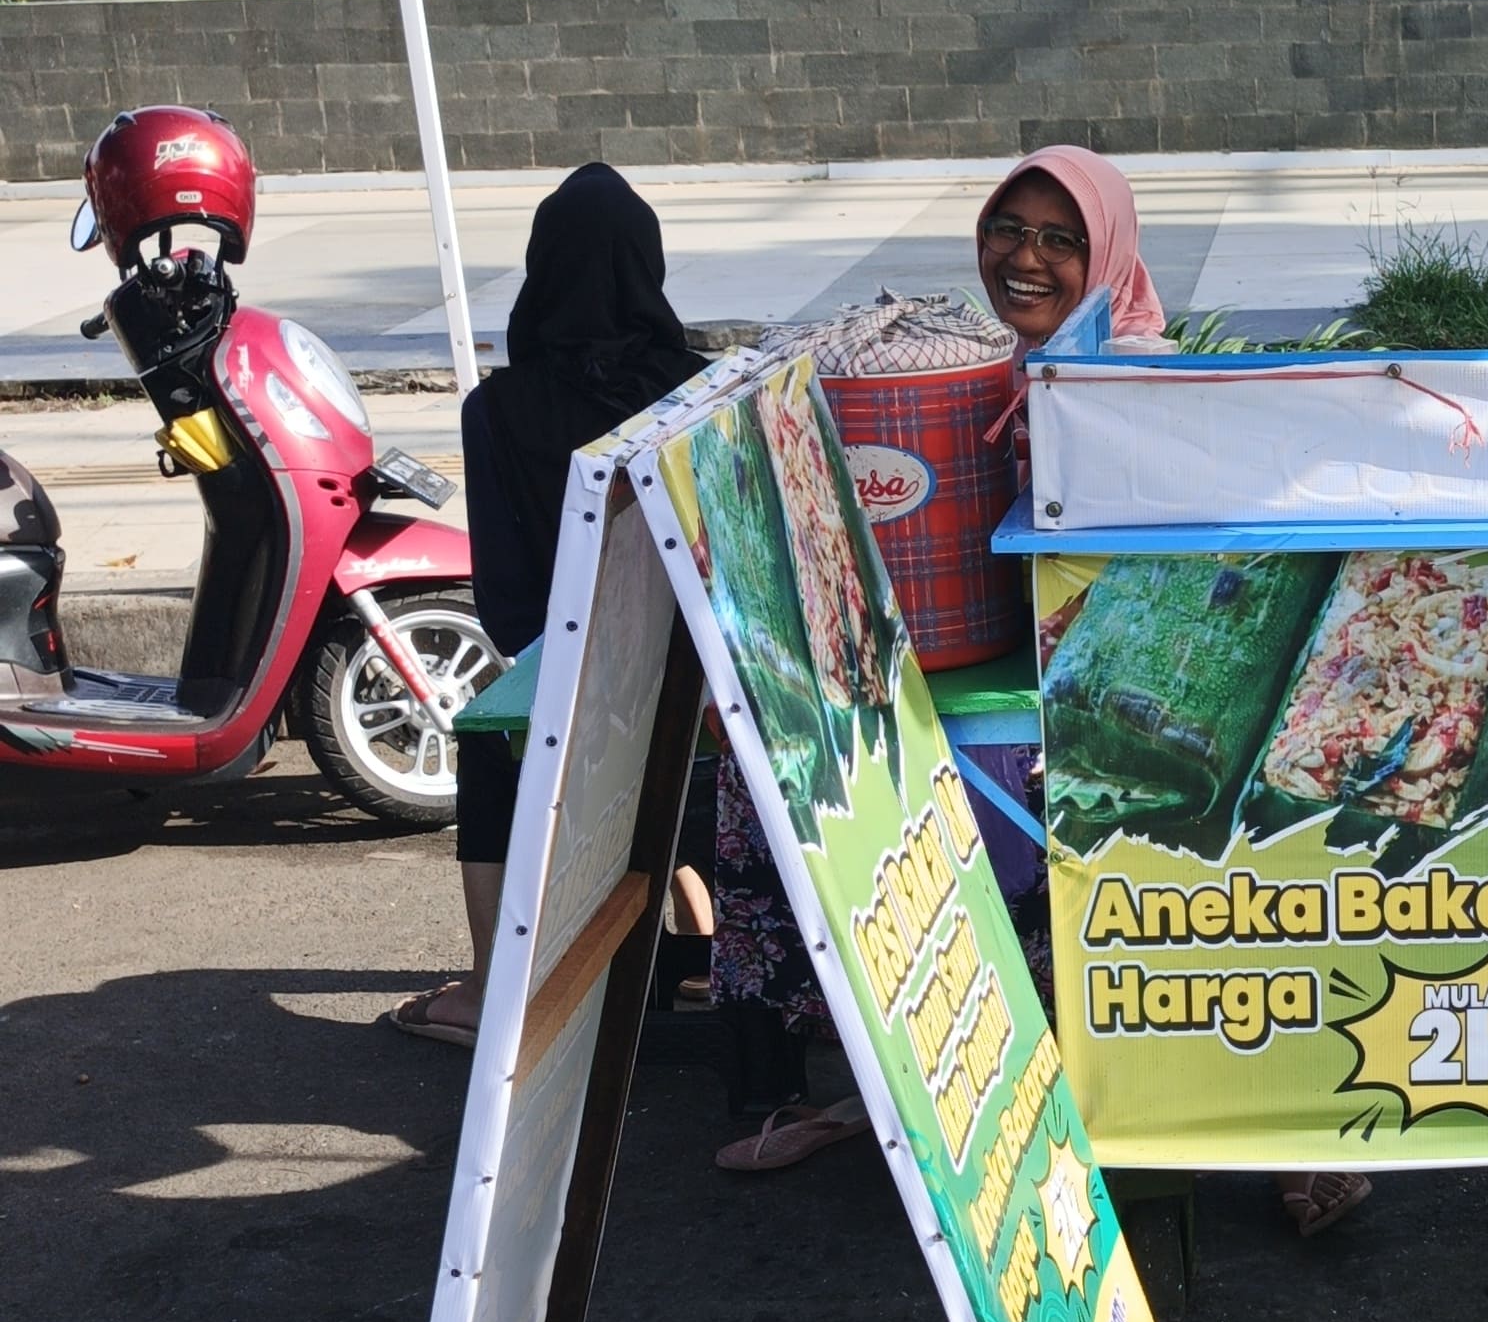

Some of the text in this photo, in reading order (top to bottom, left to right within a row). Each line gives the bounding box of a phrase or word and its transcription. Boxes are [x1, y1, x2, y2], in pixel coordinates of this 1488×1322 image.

[882, 807, 957, 955] Bakar
[932, 764, 980, 865] 8k
[1084, 871, 1325, 943] Aneka
[905, 911, 981, 1084] Ayam Suwir
[934, 970, 1012, 1166] Ikan Tongkol
[1088, 964, 1317, 1047] Harga
[969, 1028, 1063, 1271] Aneka Bakaran
